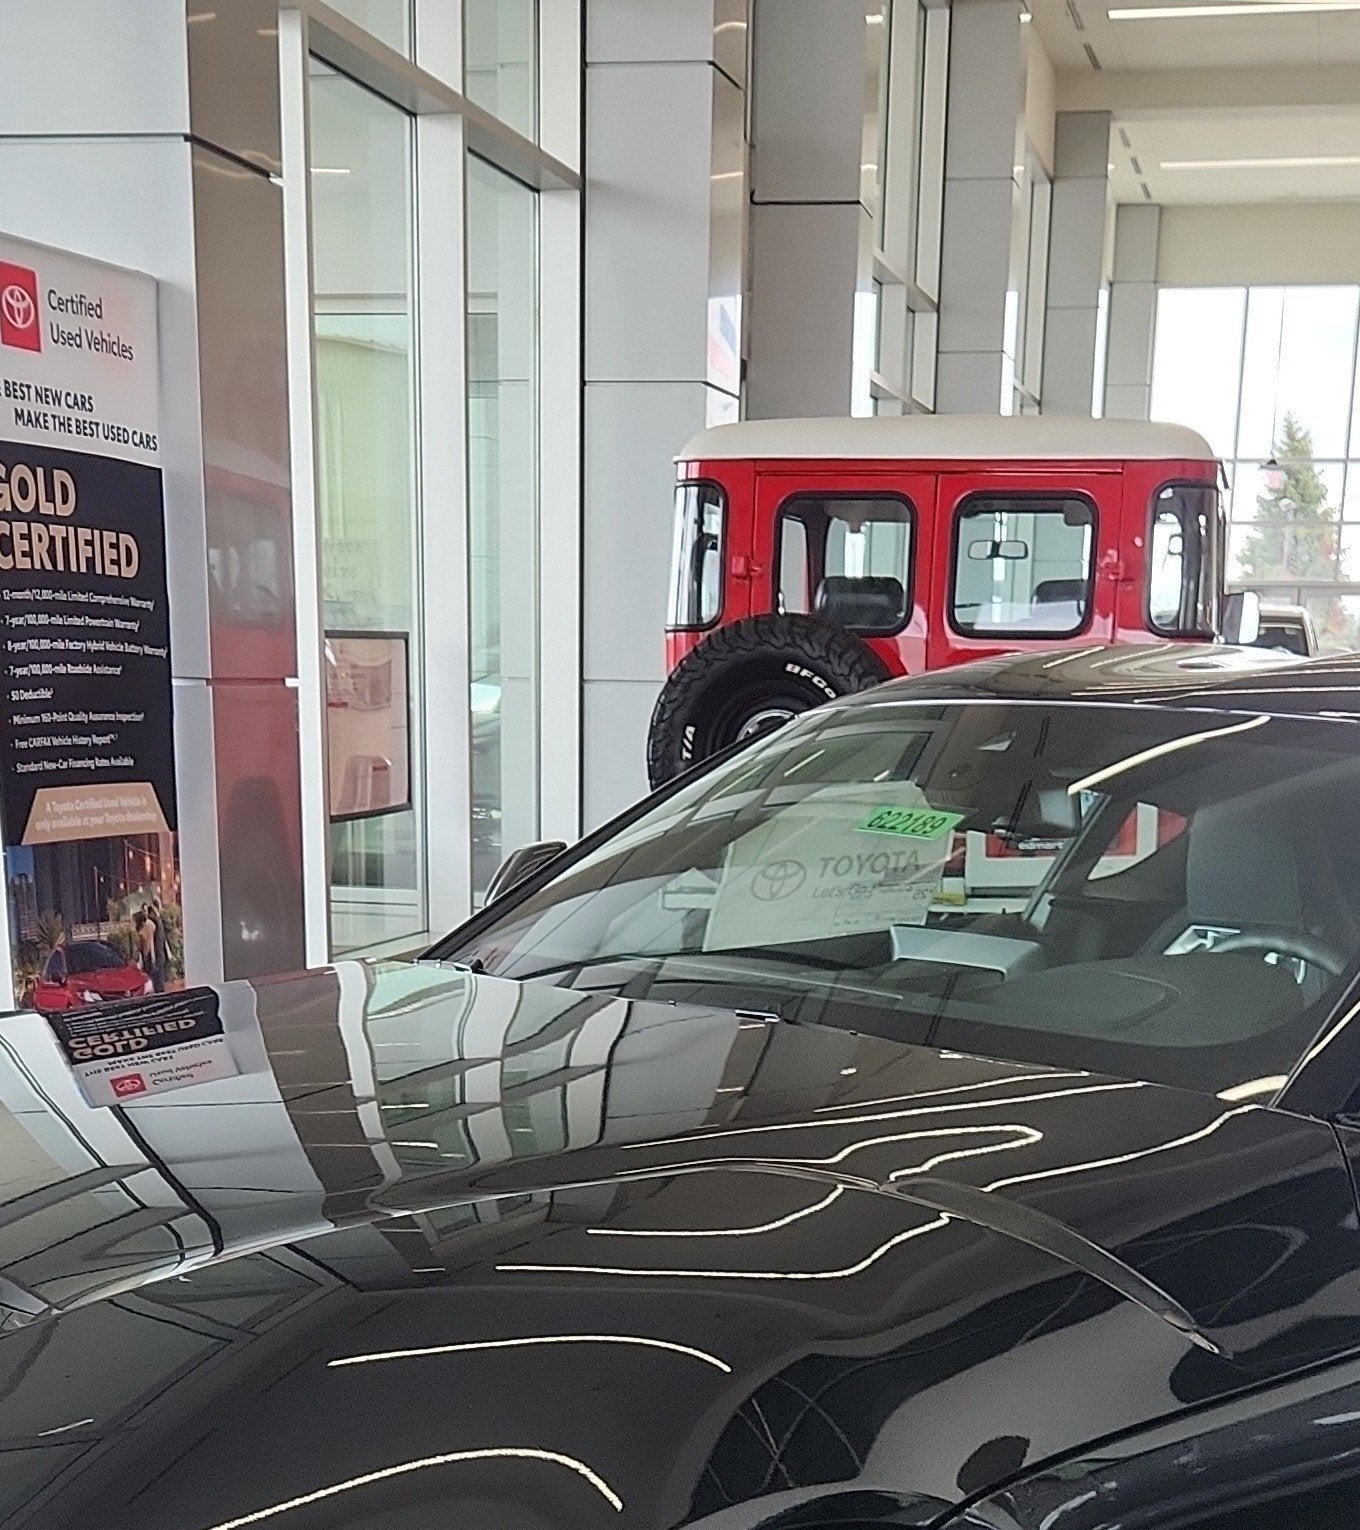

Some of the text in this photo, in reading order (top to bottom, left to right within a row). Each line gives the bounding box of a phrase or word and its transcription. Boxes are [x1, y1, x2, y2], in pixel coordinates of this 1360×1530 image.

[47, 288, 103, 319] Certified
[49, 321, 134, 361] Used Vehicles
[3, 379, 32, 402] BEST
[34, 385, 63, 408] NEW
[64, 391, 94, 413] CARS
[13, 407, 158, 451] MAKE THE BEST USED CARS
[867, 810, 948, 835] 622189
[820, 850, 920, 879] TOYOTA
